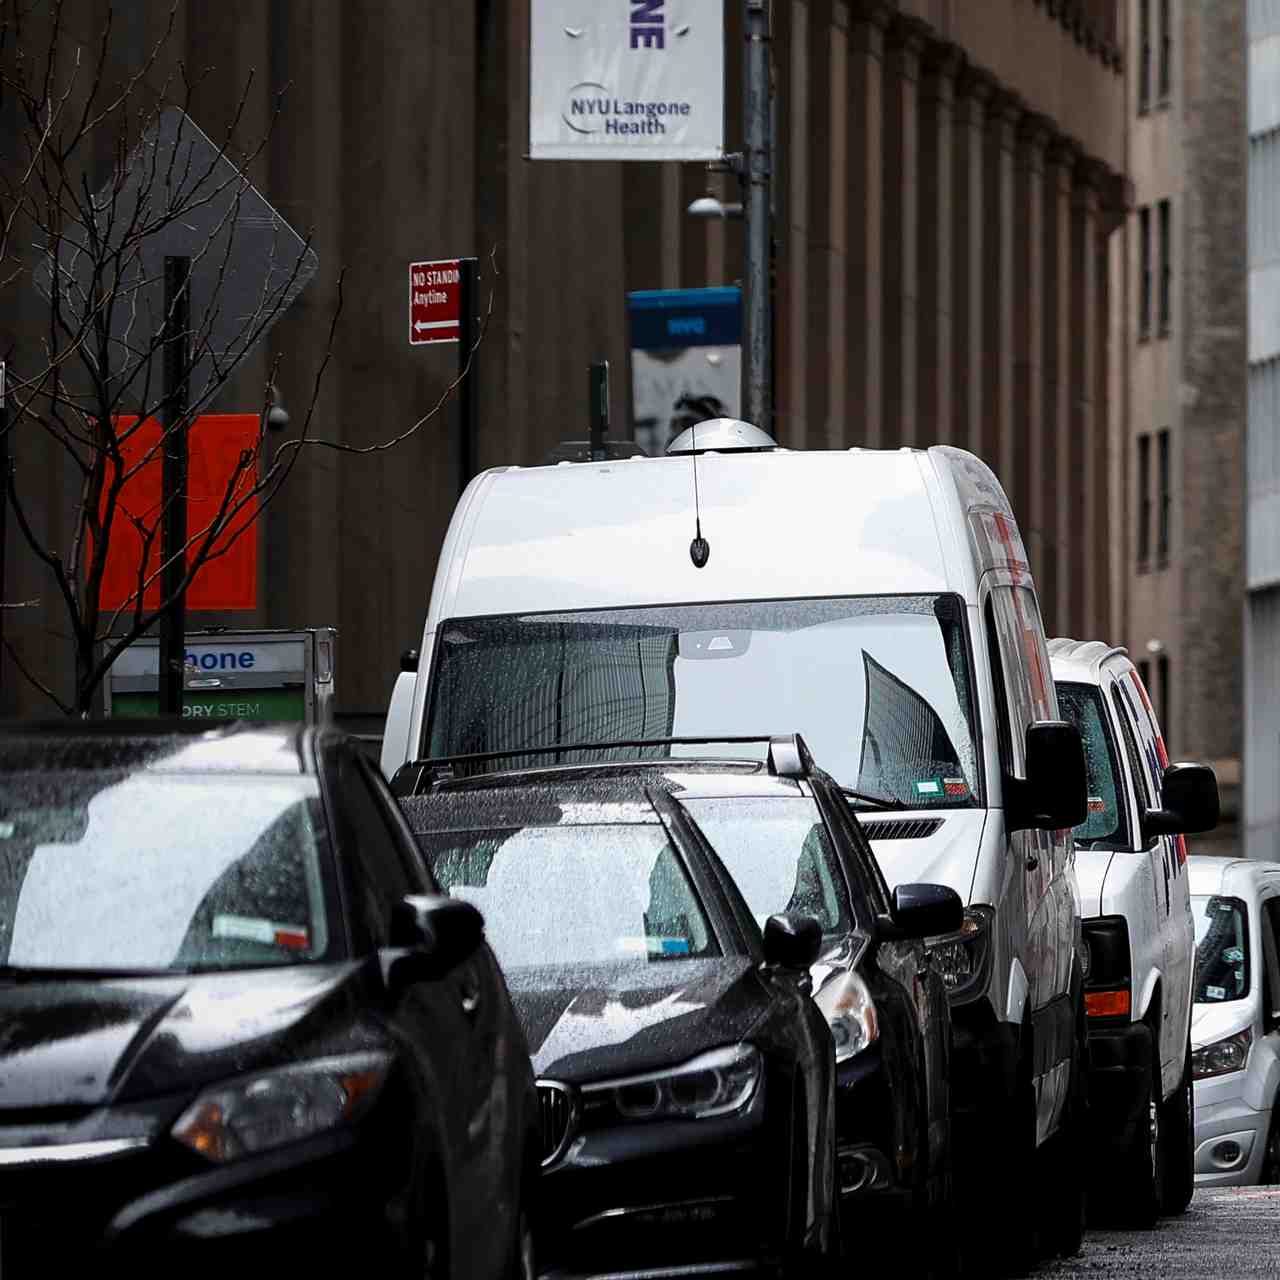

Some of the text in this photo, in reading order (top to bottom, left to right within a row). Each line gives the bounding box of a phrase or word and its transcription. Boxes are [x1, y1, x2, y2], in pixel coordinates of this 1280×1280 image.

[571, 99, 691, 118] NYU Langone
[605, 119, 666, 135] Health
[413, 272, 425, 287] NO
[413, 289, 448, 308] Anytime
[183, 649, 255, 671] hone
